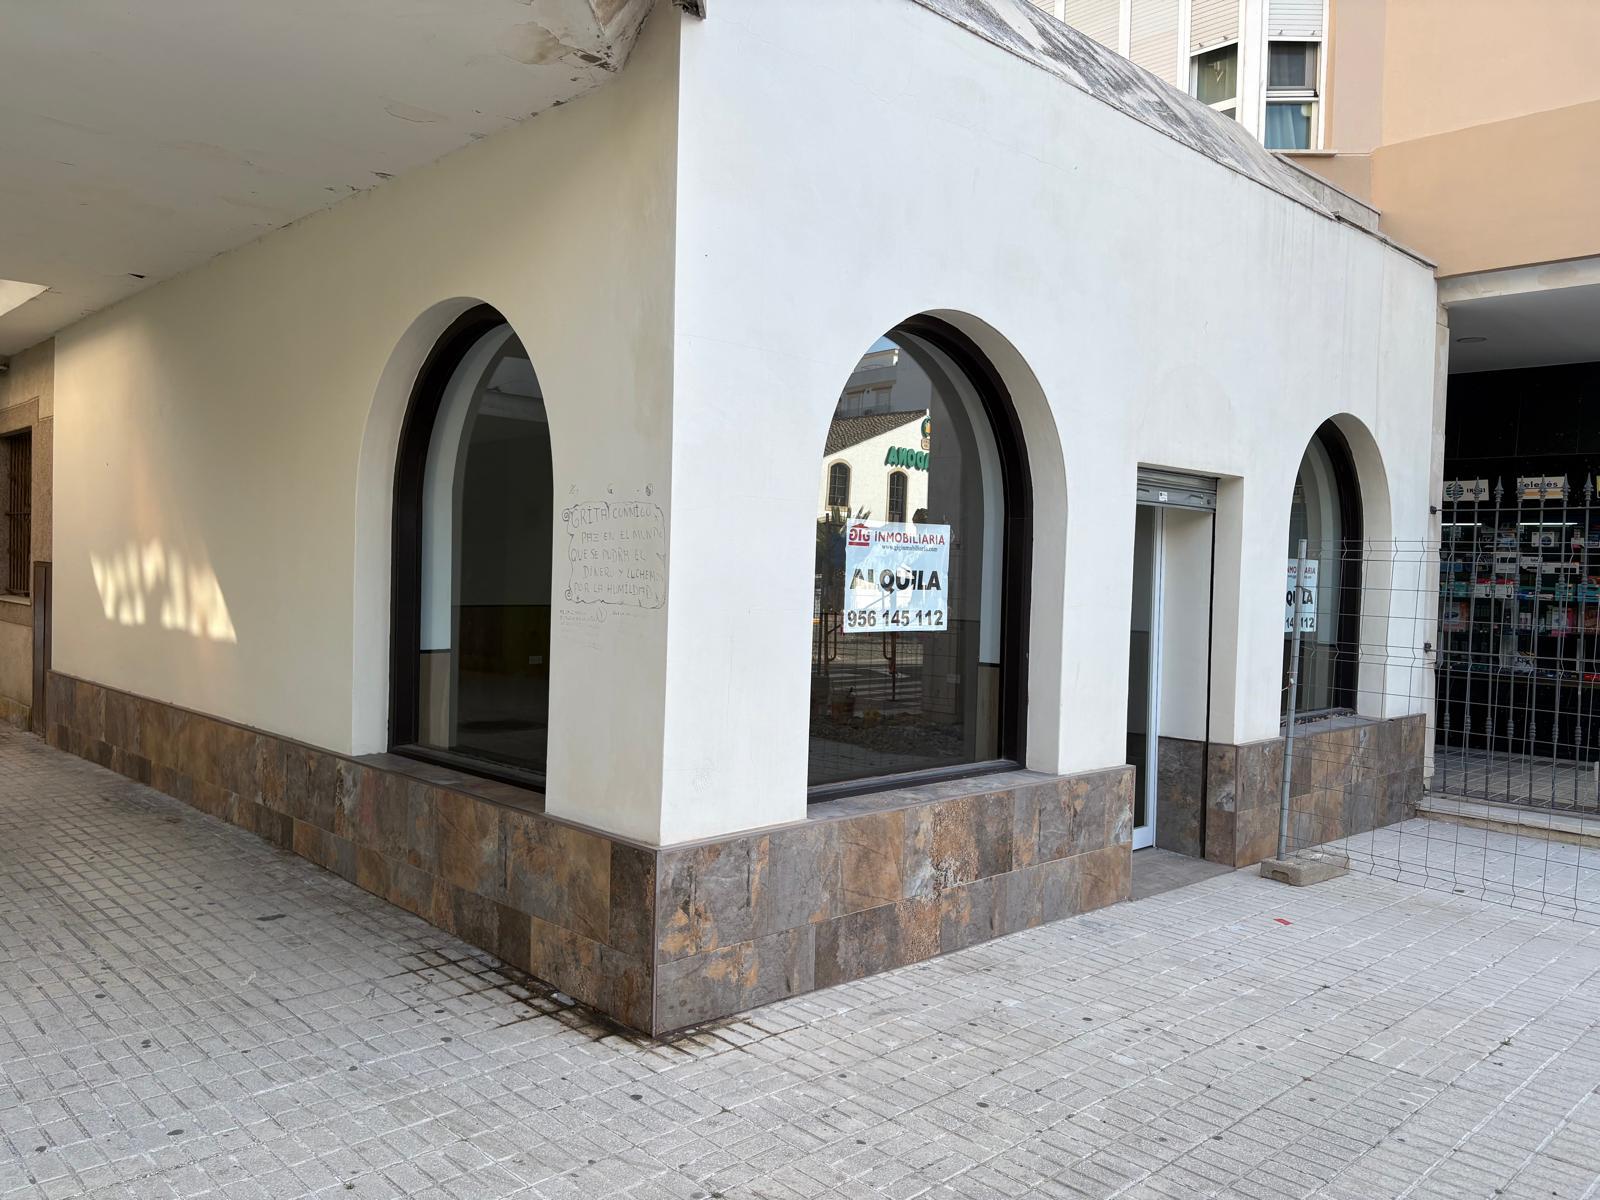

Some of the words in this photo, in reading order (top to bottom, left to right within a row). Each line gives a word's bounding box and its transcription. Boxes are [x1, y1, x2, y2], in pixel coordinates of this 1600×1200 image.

[1518, 480, 1558, 488] Teleés
[571, 505, 609, 528] GRITA
[874, 531, 945, 545] INMOBILIARIA
[849, 568, 942, 594] ALQUILA
[847, 610, 877, 627] 956
[882, 609, 910, 627] 145
[915, 609, 944, 626] 112
